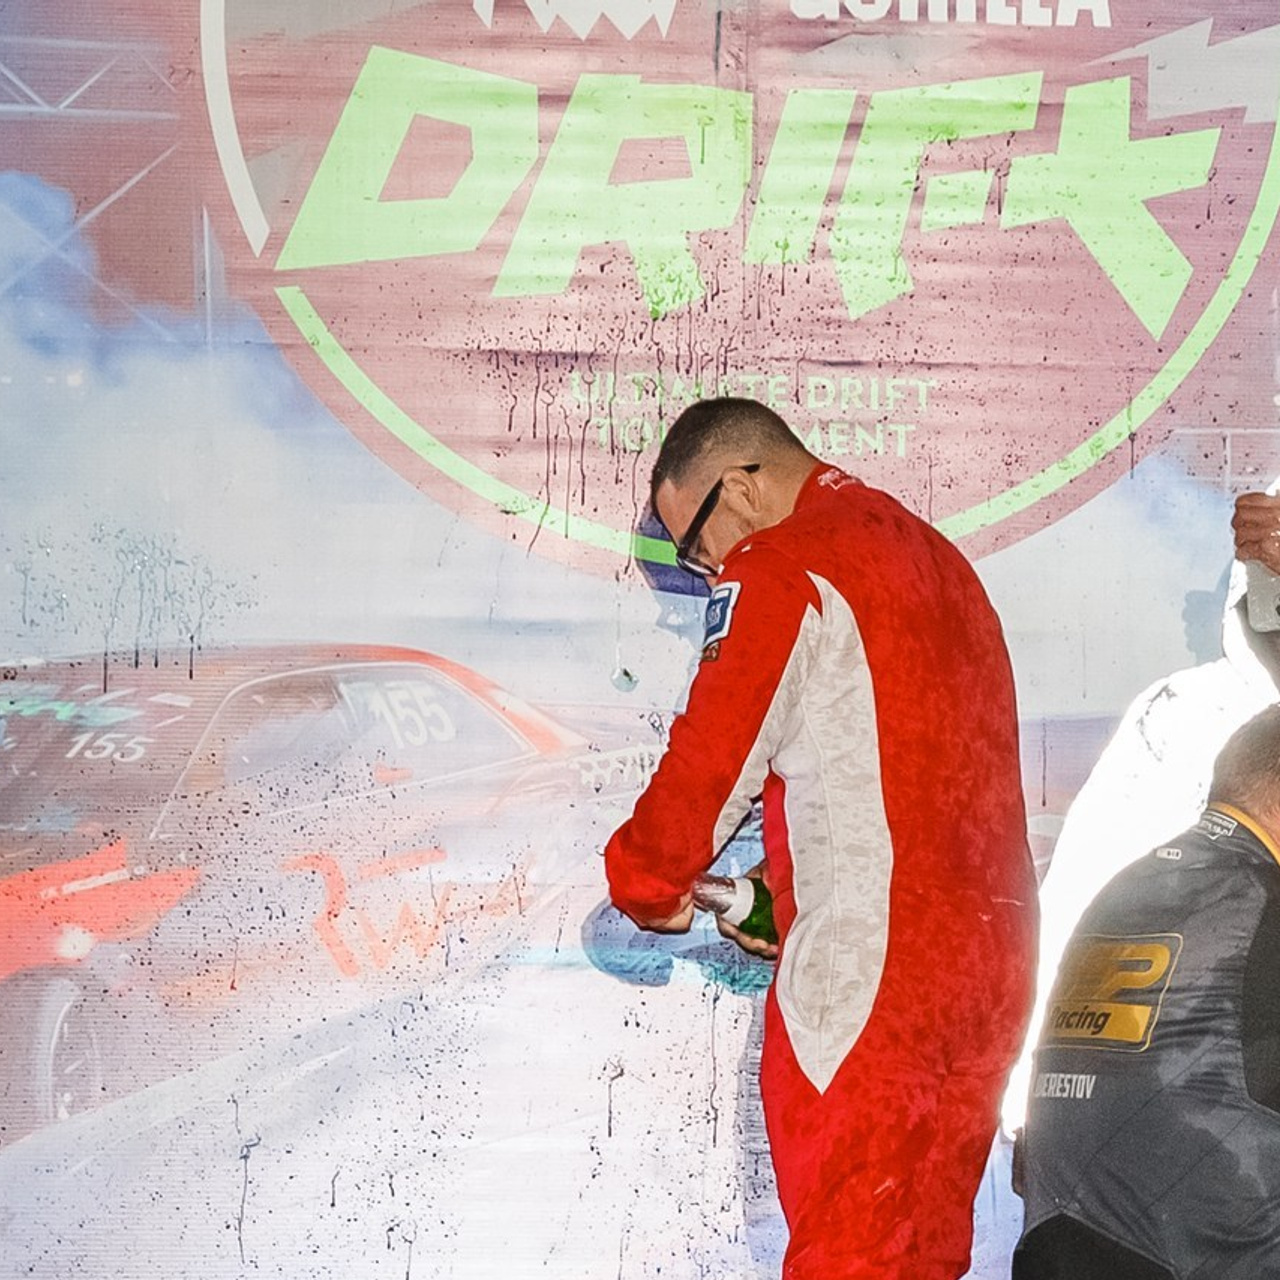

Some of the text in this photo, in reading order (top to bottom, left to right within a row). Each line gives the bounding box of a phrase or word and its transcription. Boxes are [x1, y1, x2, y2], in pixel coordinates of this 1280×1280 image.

[808, 376, 936, 412] DRIFT
[592, 418, 916, 457] TOMENT
[369, 680, 456, 749] 155
[65, 731, 155, 763] 155
